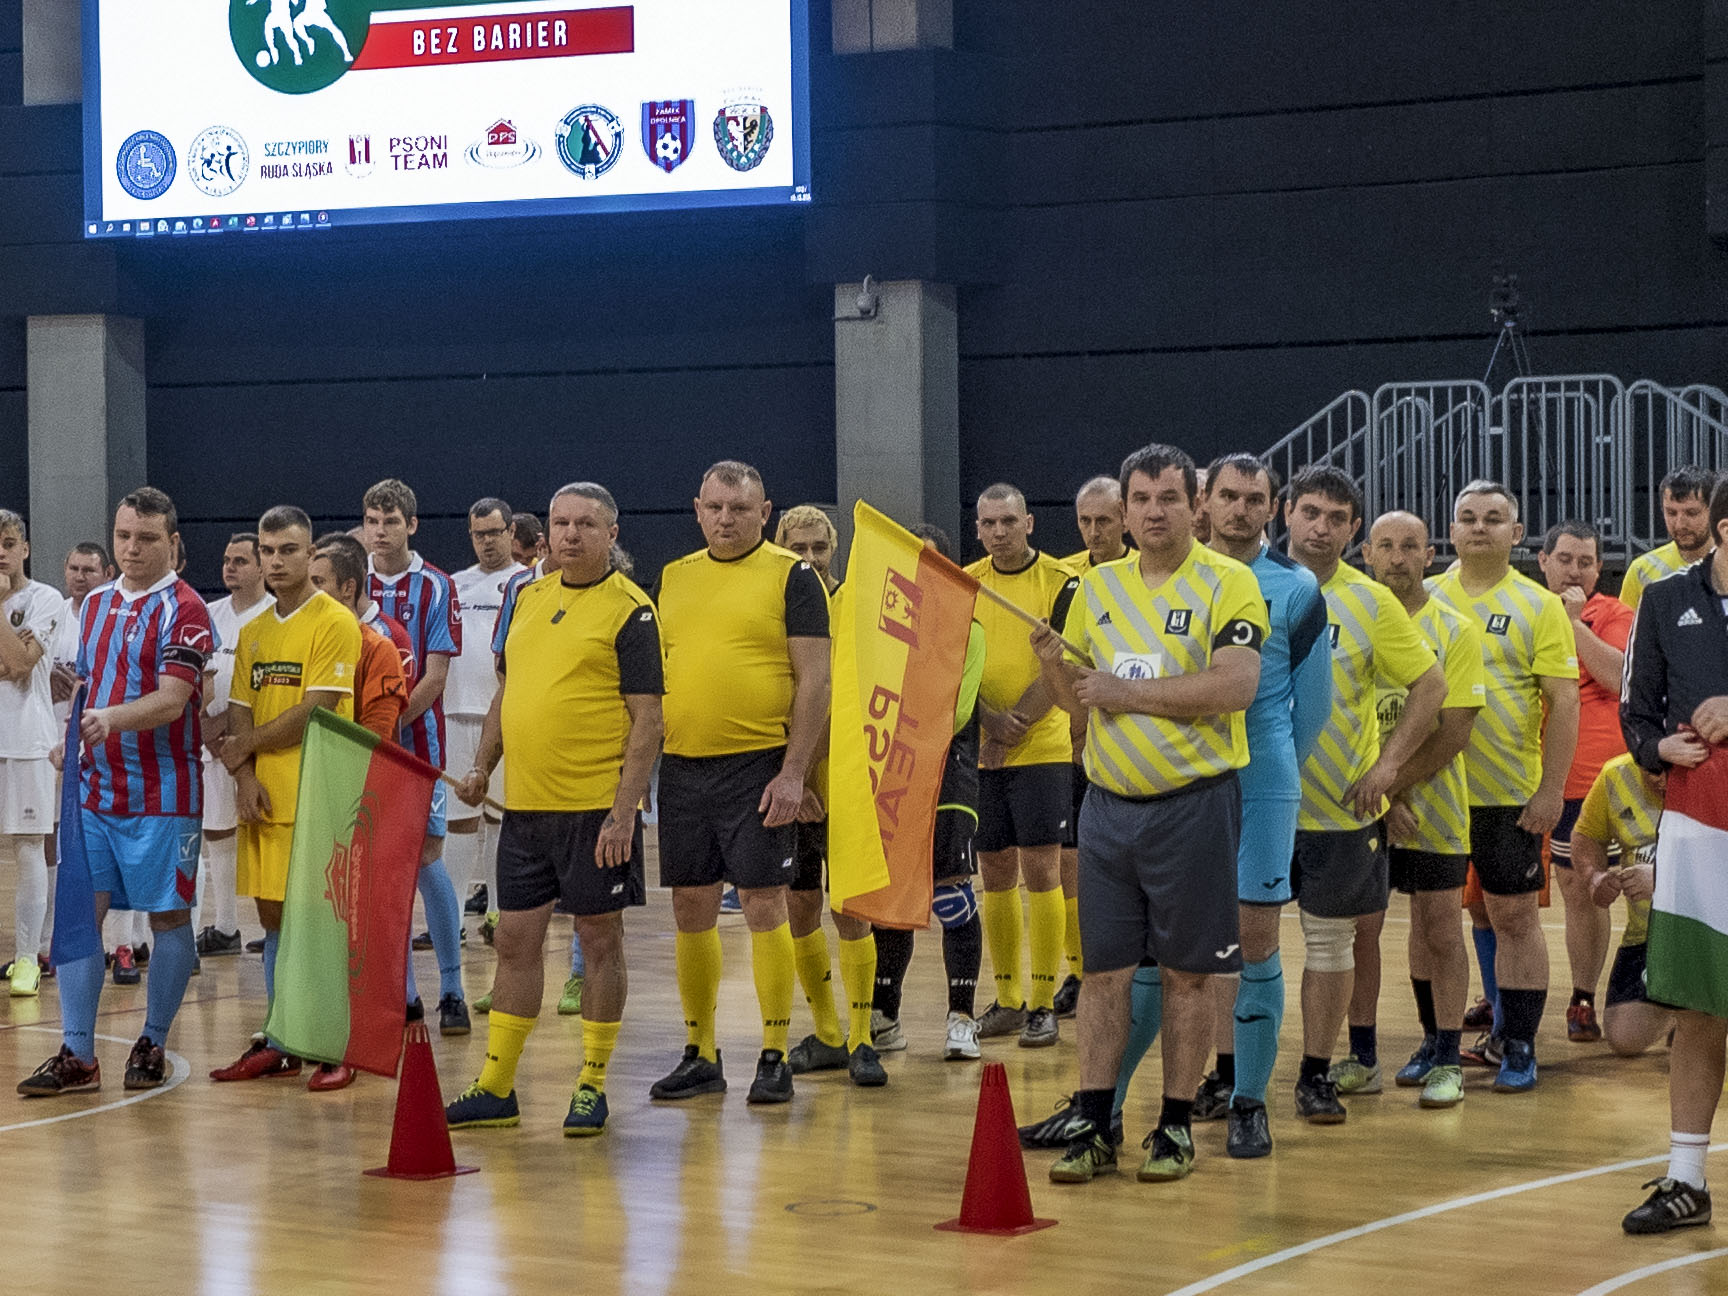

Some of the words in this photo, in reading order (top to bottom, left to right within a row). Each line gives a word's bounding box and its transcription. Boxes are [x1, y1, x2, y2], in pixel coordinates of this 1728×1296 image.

[413, 27, 458, 55] BEZ
[473, 20, 568, 51] BARIER
[389, 134, 448, 154] PSONI
[488, 130, 517, 145] DPS
[264, 139, 330, 158] SZCZYPIORY
[390, 153, 449, 171] TEAM
[260, 163, 290, 180] RUDA
